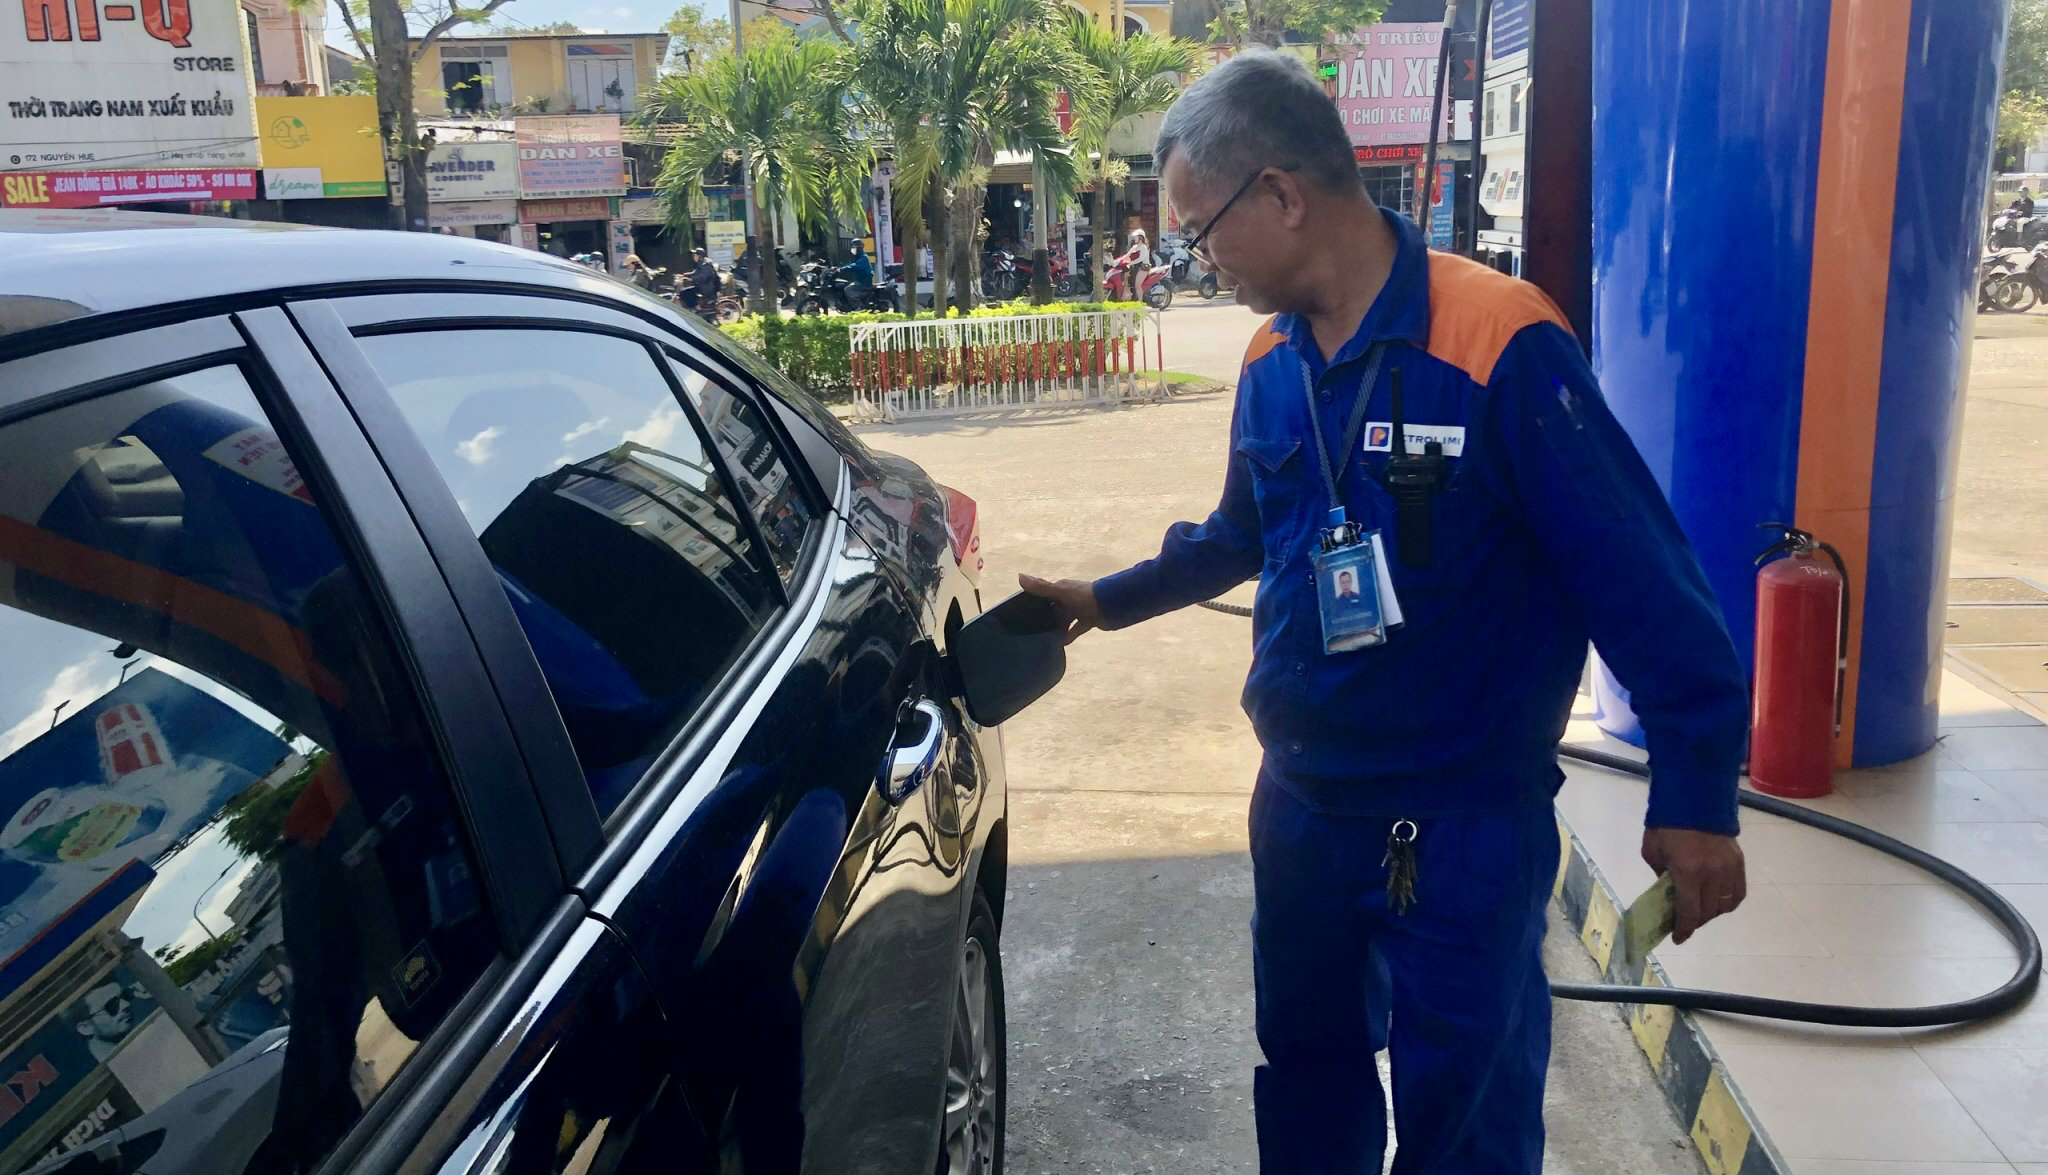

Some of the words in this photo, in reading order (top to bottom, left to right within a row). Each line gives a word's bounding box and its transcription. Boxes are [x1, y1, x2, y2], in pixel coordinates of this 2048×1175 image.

[173, 57, 235, 72] STORE
[1403, 58, 1440, 97] XE
[8, 96, 46, 119] THỜI
[50, 99, 101, 118] TRANG
[107, 101, 144, 117] NAM
[149, 93, 187, 117] XUẤT
[191, 91, 234, 117] KHẨU
[1353, 107, 1385, 125] CHƠI
[1388, 107, 1405, 124] XE
[1410, 105, 1432, 123] MÁ
[25, 154, 37, 162] 172
[519, 145, 577, 160] DÁN
[587, 145, 620, 157] XE
[430, 160, 496, 173] AVENDER
[434, 174, 484, 182] COSMETIC
[4, 175, 50, 204] SALE
[54, 177, 76, 193] JEAN
[1404, 434, 1463, 445] TROLIM
